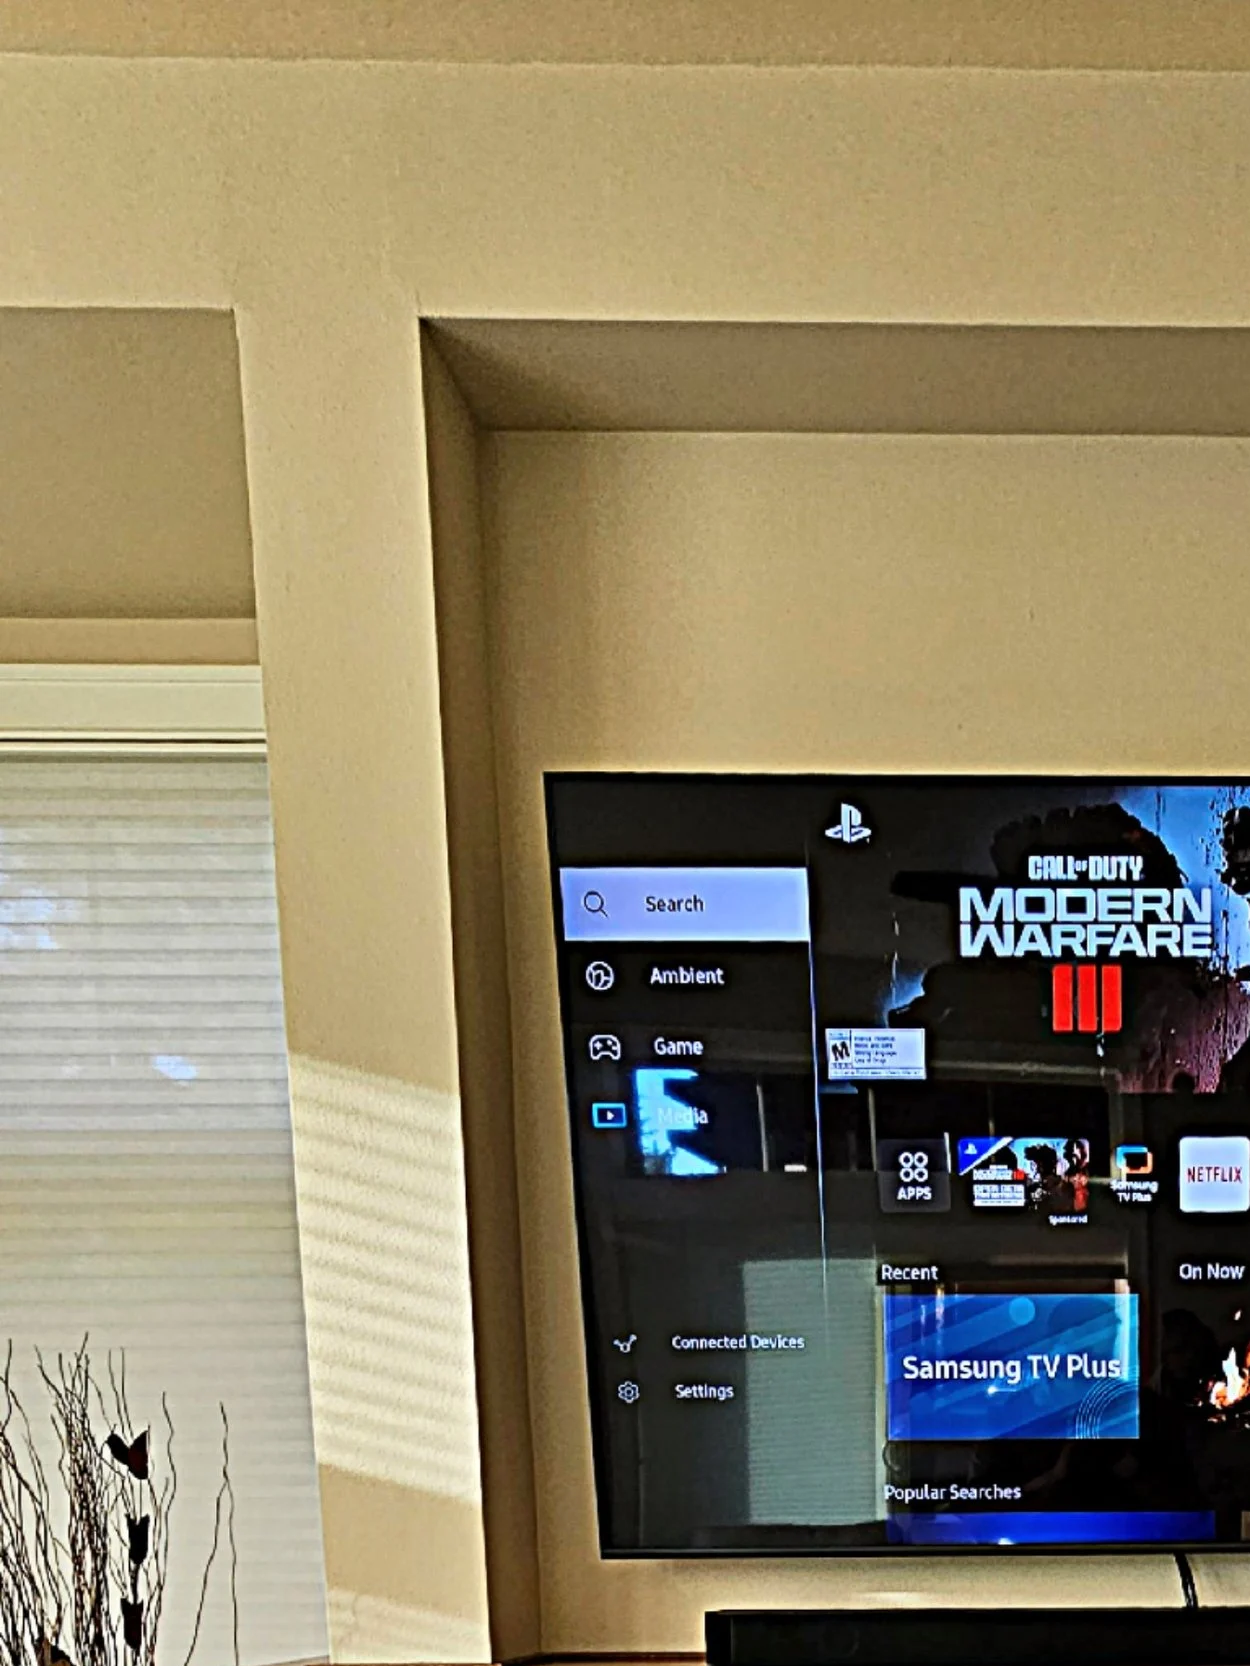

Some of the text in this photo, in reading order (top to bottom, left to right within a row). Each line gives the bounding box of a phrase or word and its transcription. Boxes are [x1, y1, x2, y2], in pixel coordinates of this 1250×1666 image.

[1028, 855, 1143, 881] CALL OF DUTY
[645, 895, 704, 913] Search
[959, 887, 1212, 923] MODERN
[959, 924, 1212, 958] WARFARE
[650, 966, 725, 985] Ambient
[654, 1037, 703, 1055] Game
[657, 1107, 709, 1124] Media
[1187, 1166, 1243, 1183] NETFLIX
[897, 1186, 932, 1200] APPS
[881, 1264, 938, 1280] Recent
[1179, 1263, 1245, 1280] On Now
[672, 1335, 805, 1349] Connected Devices
[902, 1354, 1122, 1383] Samsung TV Plus
[675, 1384, 734, 1401] Settings
[884, 1484, 1021, 1503] Popular Searches
